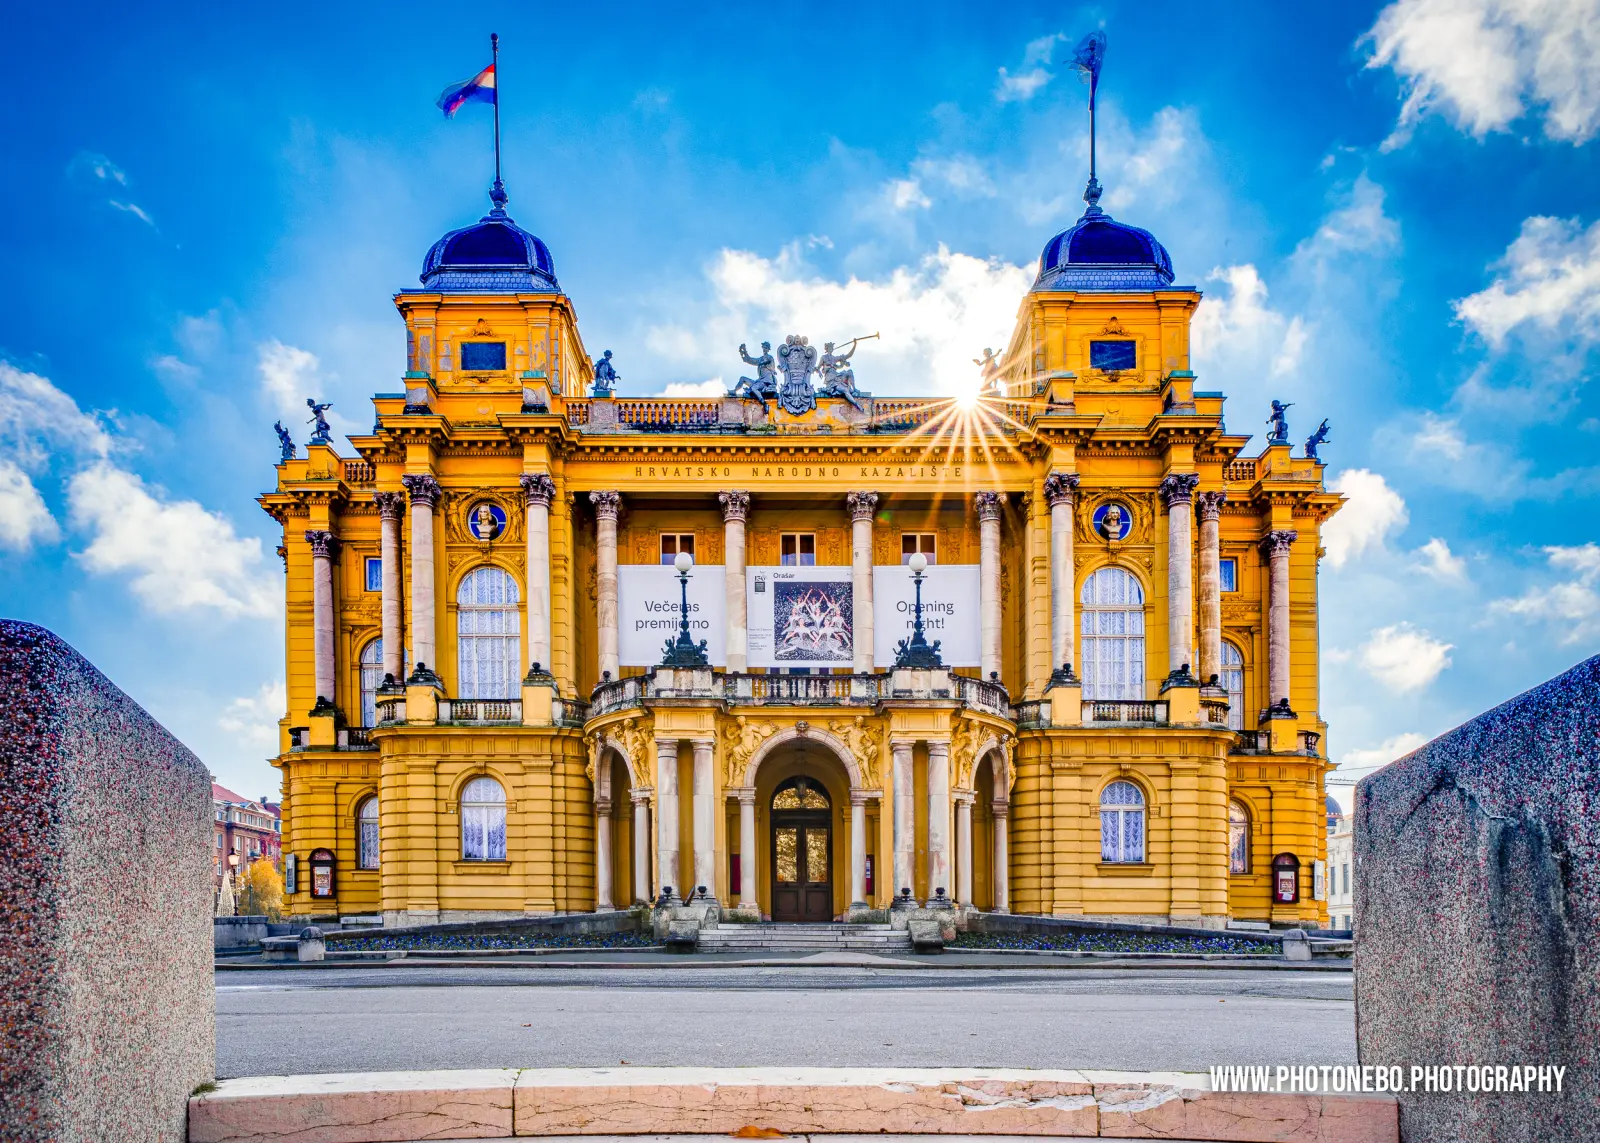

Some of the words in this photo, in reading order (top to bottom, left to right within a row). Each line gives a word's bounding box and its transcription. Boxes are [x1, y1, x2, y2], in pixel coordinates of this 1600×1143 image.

[635, 466, 730, 477] HRVATSKO
[751, 466, 839, 477] NARODNO
[860, 465, 962, 477] KAZALIŠTE
[896, 600, 954, 615] Opening
[635, 617, 709, 631] premijrno
[906, 617, 945, 631] nght!
